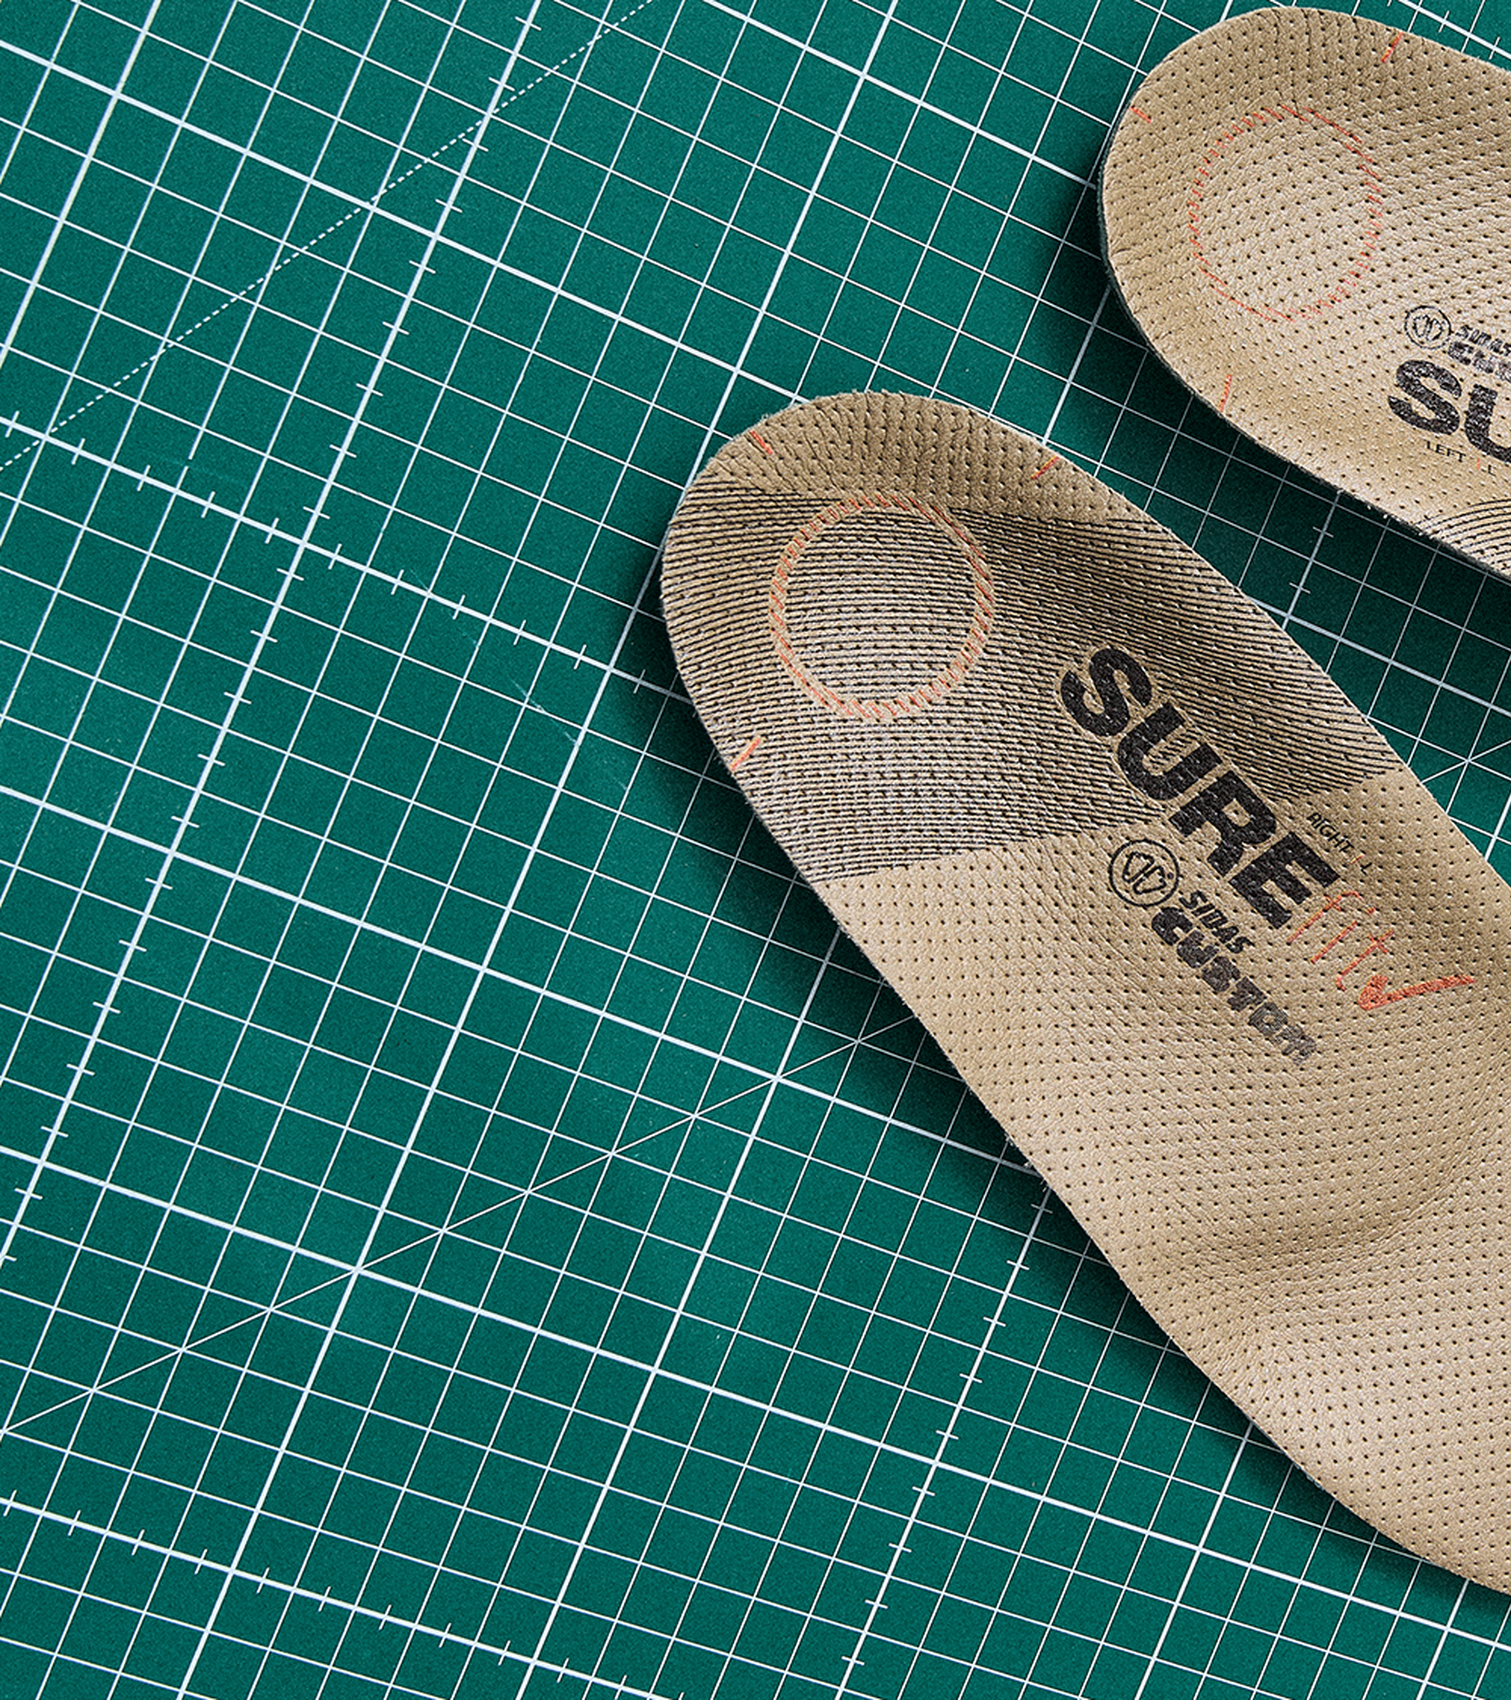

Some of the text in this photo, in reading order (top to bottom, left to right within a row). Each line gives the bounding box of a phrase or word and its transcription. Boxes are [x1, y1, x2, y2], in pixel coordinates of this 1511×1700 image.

[1424, 439, 1467, 463] LEFT
[1306, 812, 1355, 853] RIGHT
[1178, 890, 1256, 955] SIDAS
